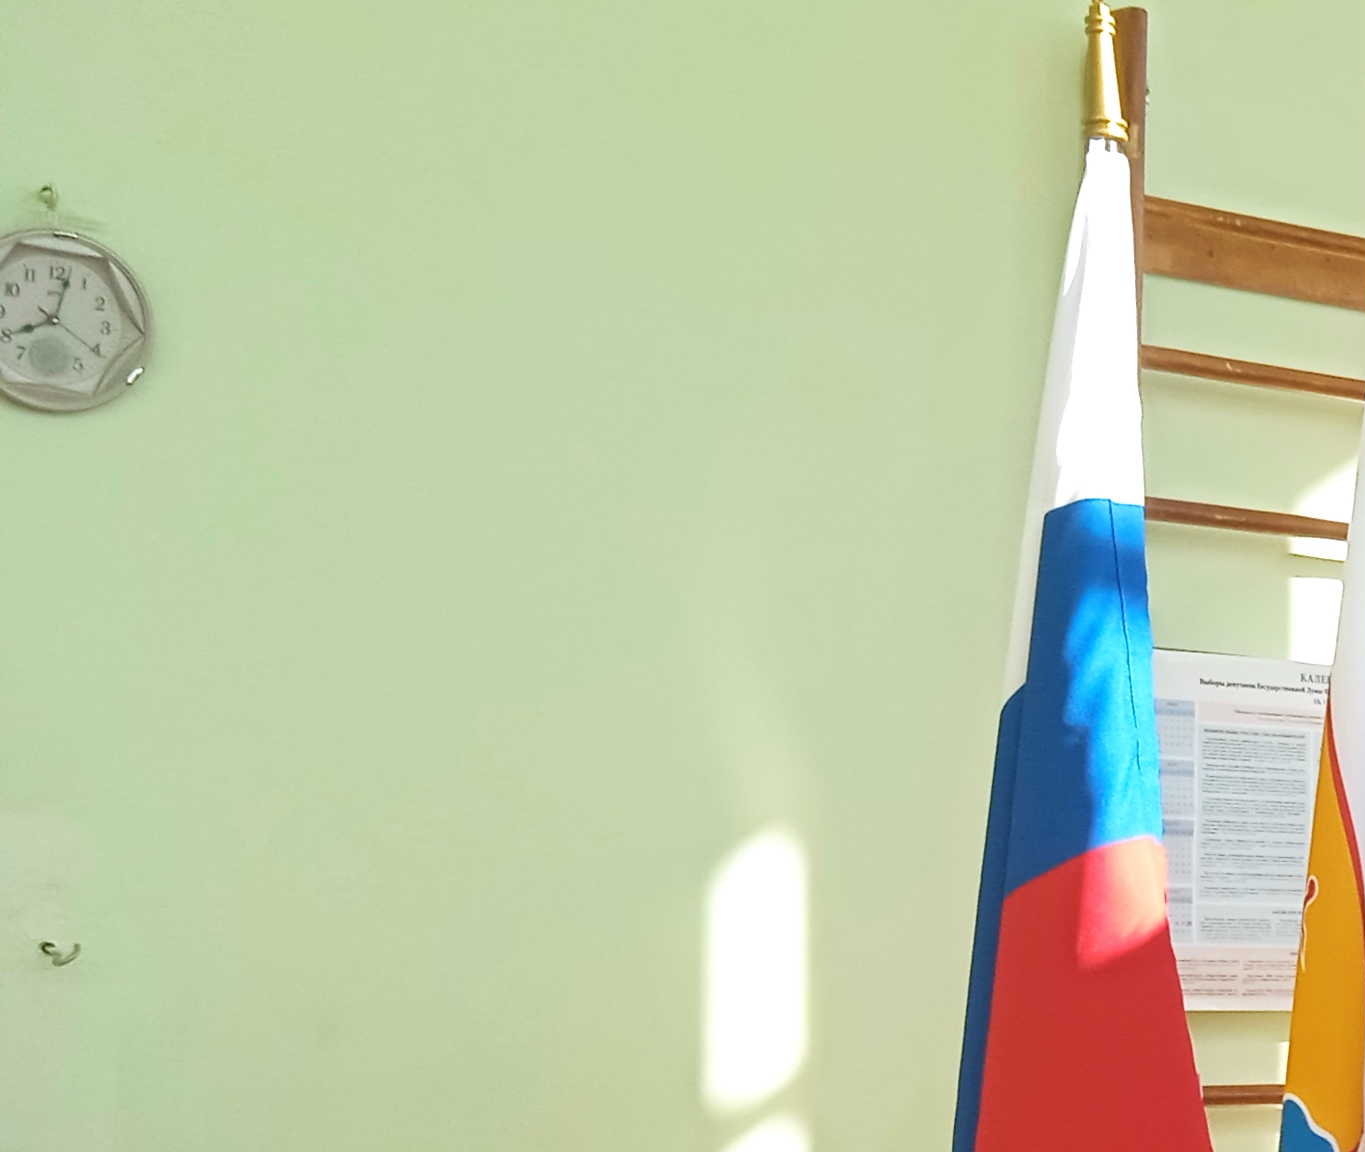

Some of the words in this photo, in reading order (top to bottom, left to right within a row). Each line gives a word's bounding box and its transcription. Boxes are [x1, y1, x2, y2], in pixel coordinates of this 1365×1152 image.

[24, 268, 36, 283] 11
[49, 265, 66, 280] 12
[5, 282, 20, 297] 10
[81, 277, 88, 290] 1
[95, 297, 106, 312] 2
[0, 329, 12, 343] 8
[100, 322, 111, 336] 3
[16, 346, 27, 361] 7
[92, 343, 102, 357] 4
[73, 358, 84, 373] 5
